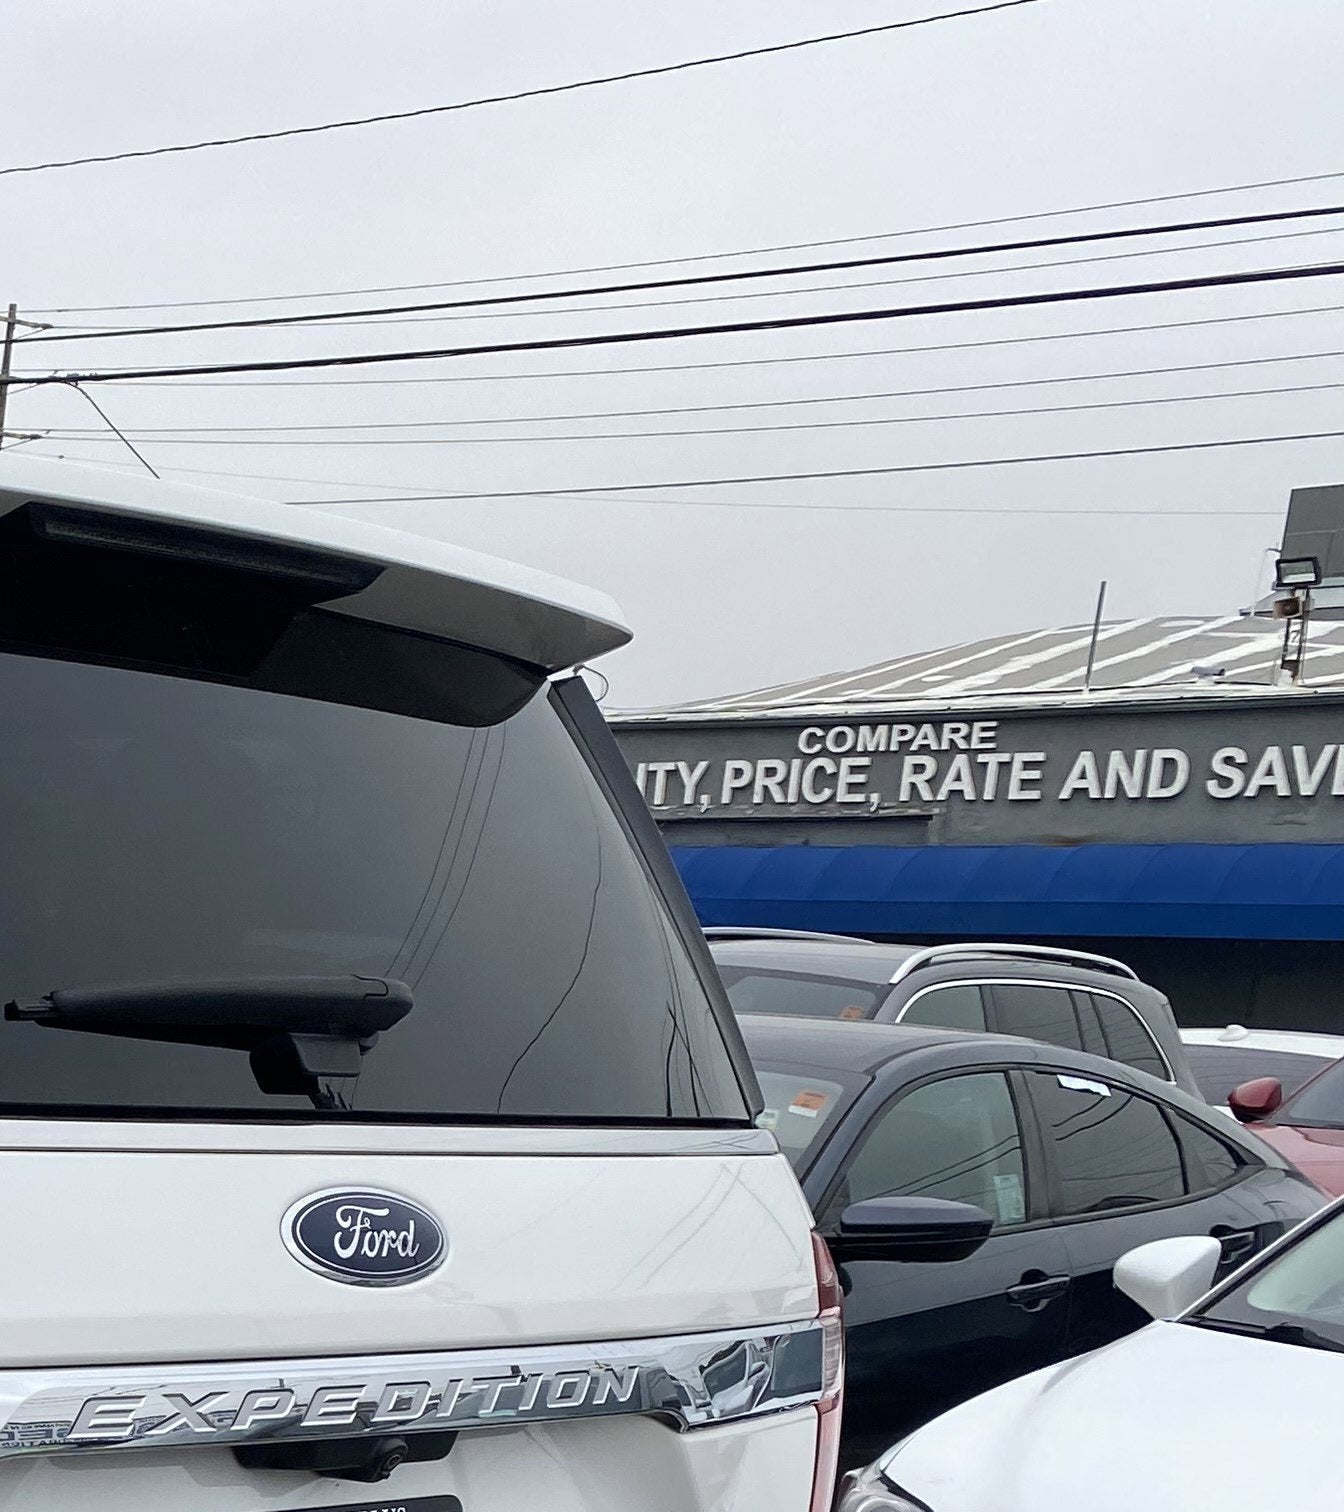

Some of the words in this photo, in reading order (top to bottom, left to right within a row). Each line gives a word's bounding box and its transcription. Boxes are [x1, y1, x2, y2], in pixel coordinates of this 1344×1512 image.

[798, 721, 999, 755] COMPARE
[720, 756, 882, 812] PRICE,
[899, 752, 1047, 802] RATE
[1059, 747, 1191, 800] AND
[333, 1204, 421, 1259] Ford
[66, 1365, 641, 1439] EXPEDITION
